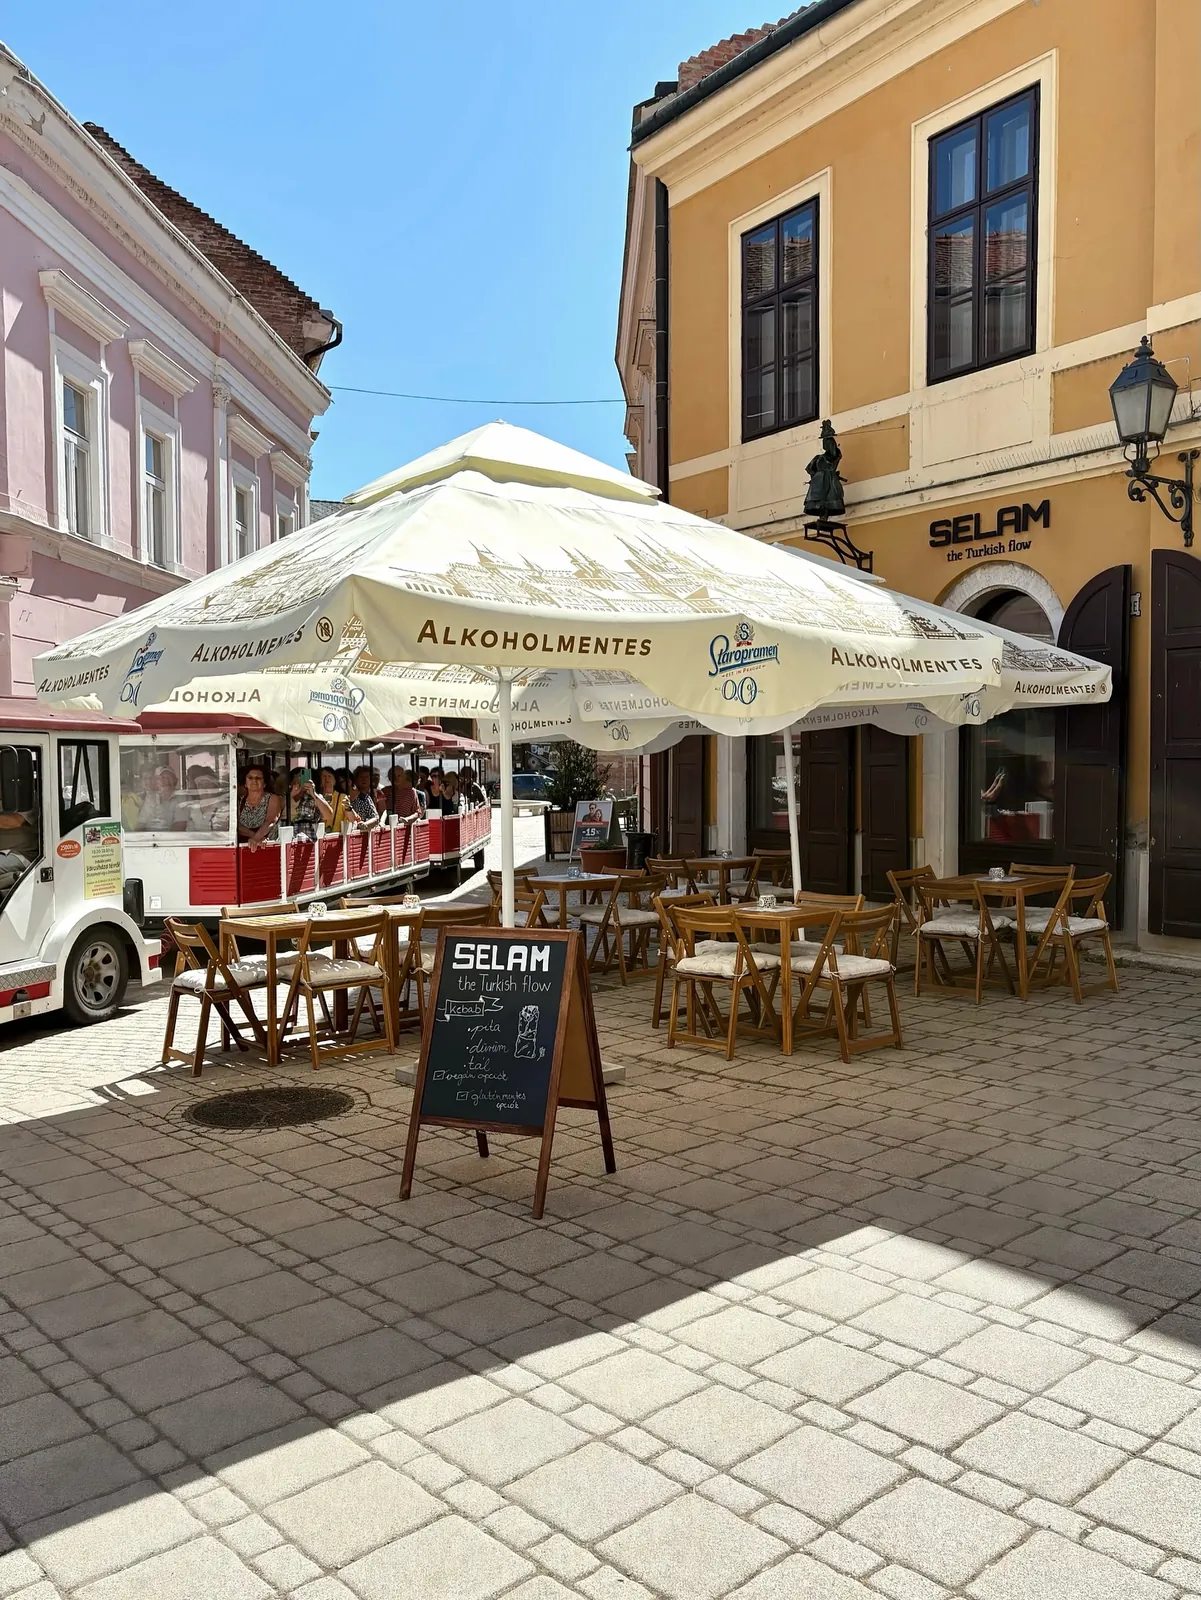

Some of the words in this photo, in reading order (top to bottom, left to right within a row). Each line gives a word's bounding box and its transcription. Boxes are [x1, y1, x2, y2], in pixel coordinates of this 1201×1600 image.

[929, 499, 1050, 548] SELAM
[947, 551, 963, 562] the
[966, 542, 1006, 559] Turkish
[1008, 539, 1032, 552] flow
[417, 619, 652, 656] ALKOHOLMENTES
[709, 634, 779, 676] Staropramen
[831, 647, 983, 674] ALKOHOLMENTES
[37, 664, 110, 693] ALKOHOLMENTES
[1014, 680, 1096, 694] ALKOHOLMENTES
[452, 943, 550, 972] SELAM
[458, 976, 476, 992] the
[479, 973, 517, 992] Turkish
[522, 975, 552, 993] flow
[450, 1001, 482, 1013] kebab
[470, 1019, 501, 1040] pita
